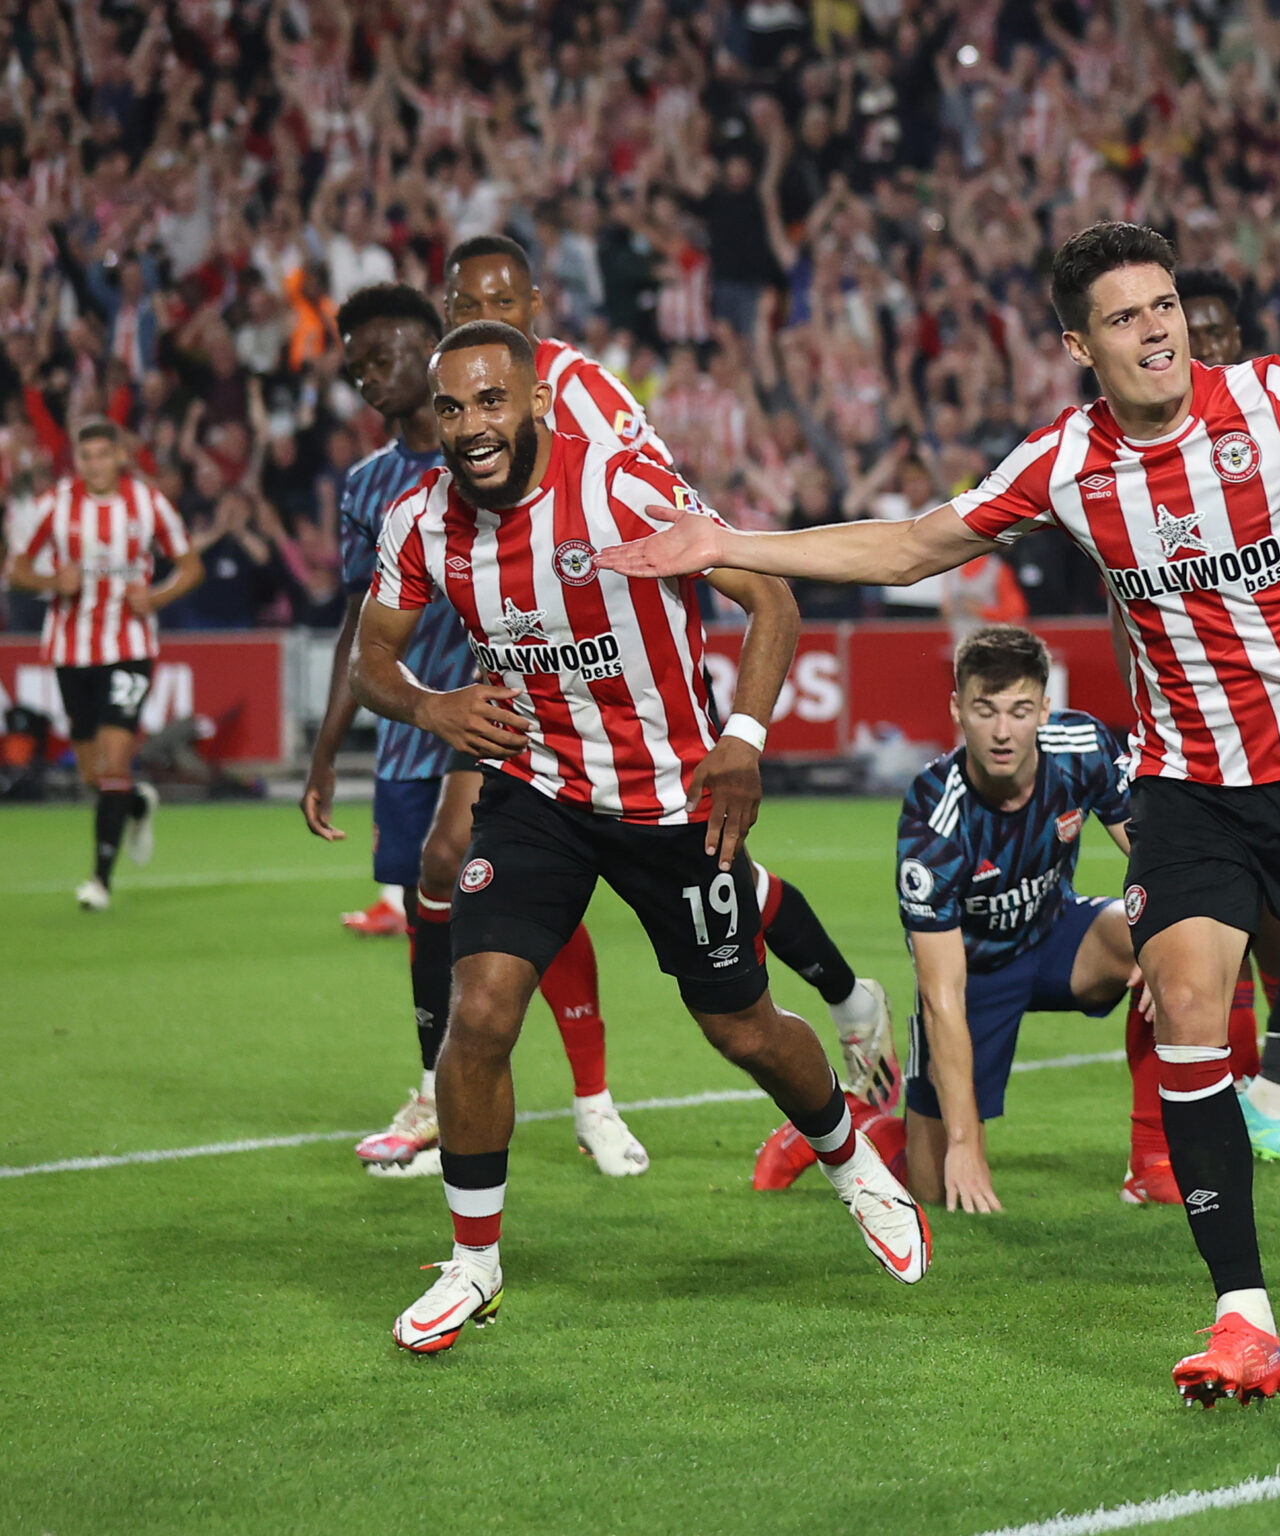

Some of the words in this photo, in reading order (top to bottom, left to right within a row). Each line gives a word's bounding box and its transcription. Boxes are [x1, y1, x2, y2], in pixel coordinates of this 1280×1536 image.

[1216, 434, 1251, 451] BRENTFORD
[1086, 490, 1113, 500] umbro
[557, 542, 591, 557] BRENTFORD
[448, 571, 469, 580] umbro
[581, 661, 623, 681] bets
[682, 872, 739, 946] 19
[988, 908, 1020, 931] FLY
[713, 956, 739, 968] umbro
[1189, 1203, 1220, 1216] umbro
